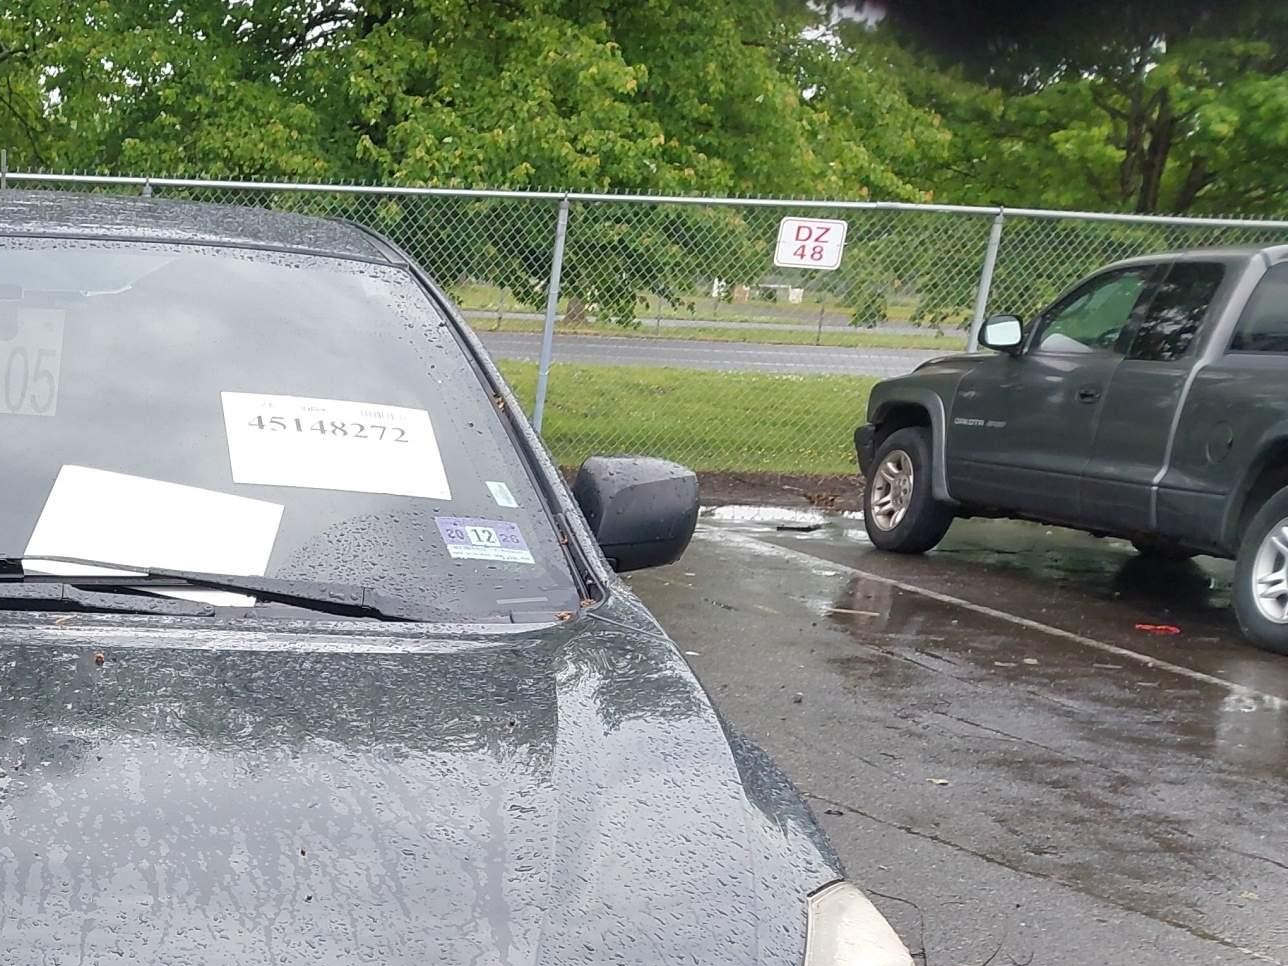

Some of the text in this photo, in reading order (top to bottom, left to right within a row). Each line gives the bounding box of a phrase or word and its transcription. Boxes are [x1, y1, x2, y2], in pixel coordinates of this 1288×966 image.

[795, 225, 831, 243] DZ
[793, 244, 824, 261] 48
[248, 415, 409, 443] 45148272
[445, 528, 465, 541] 20
[471, 528, 497, 544] 12
